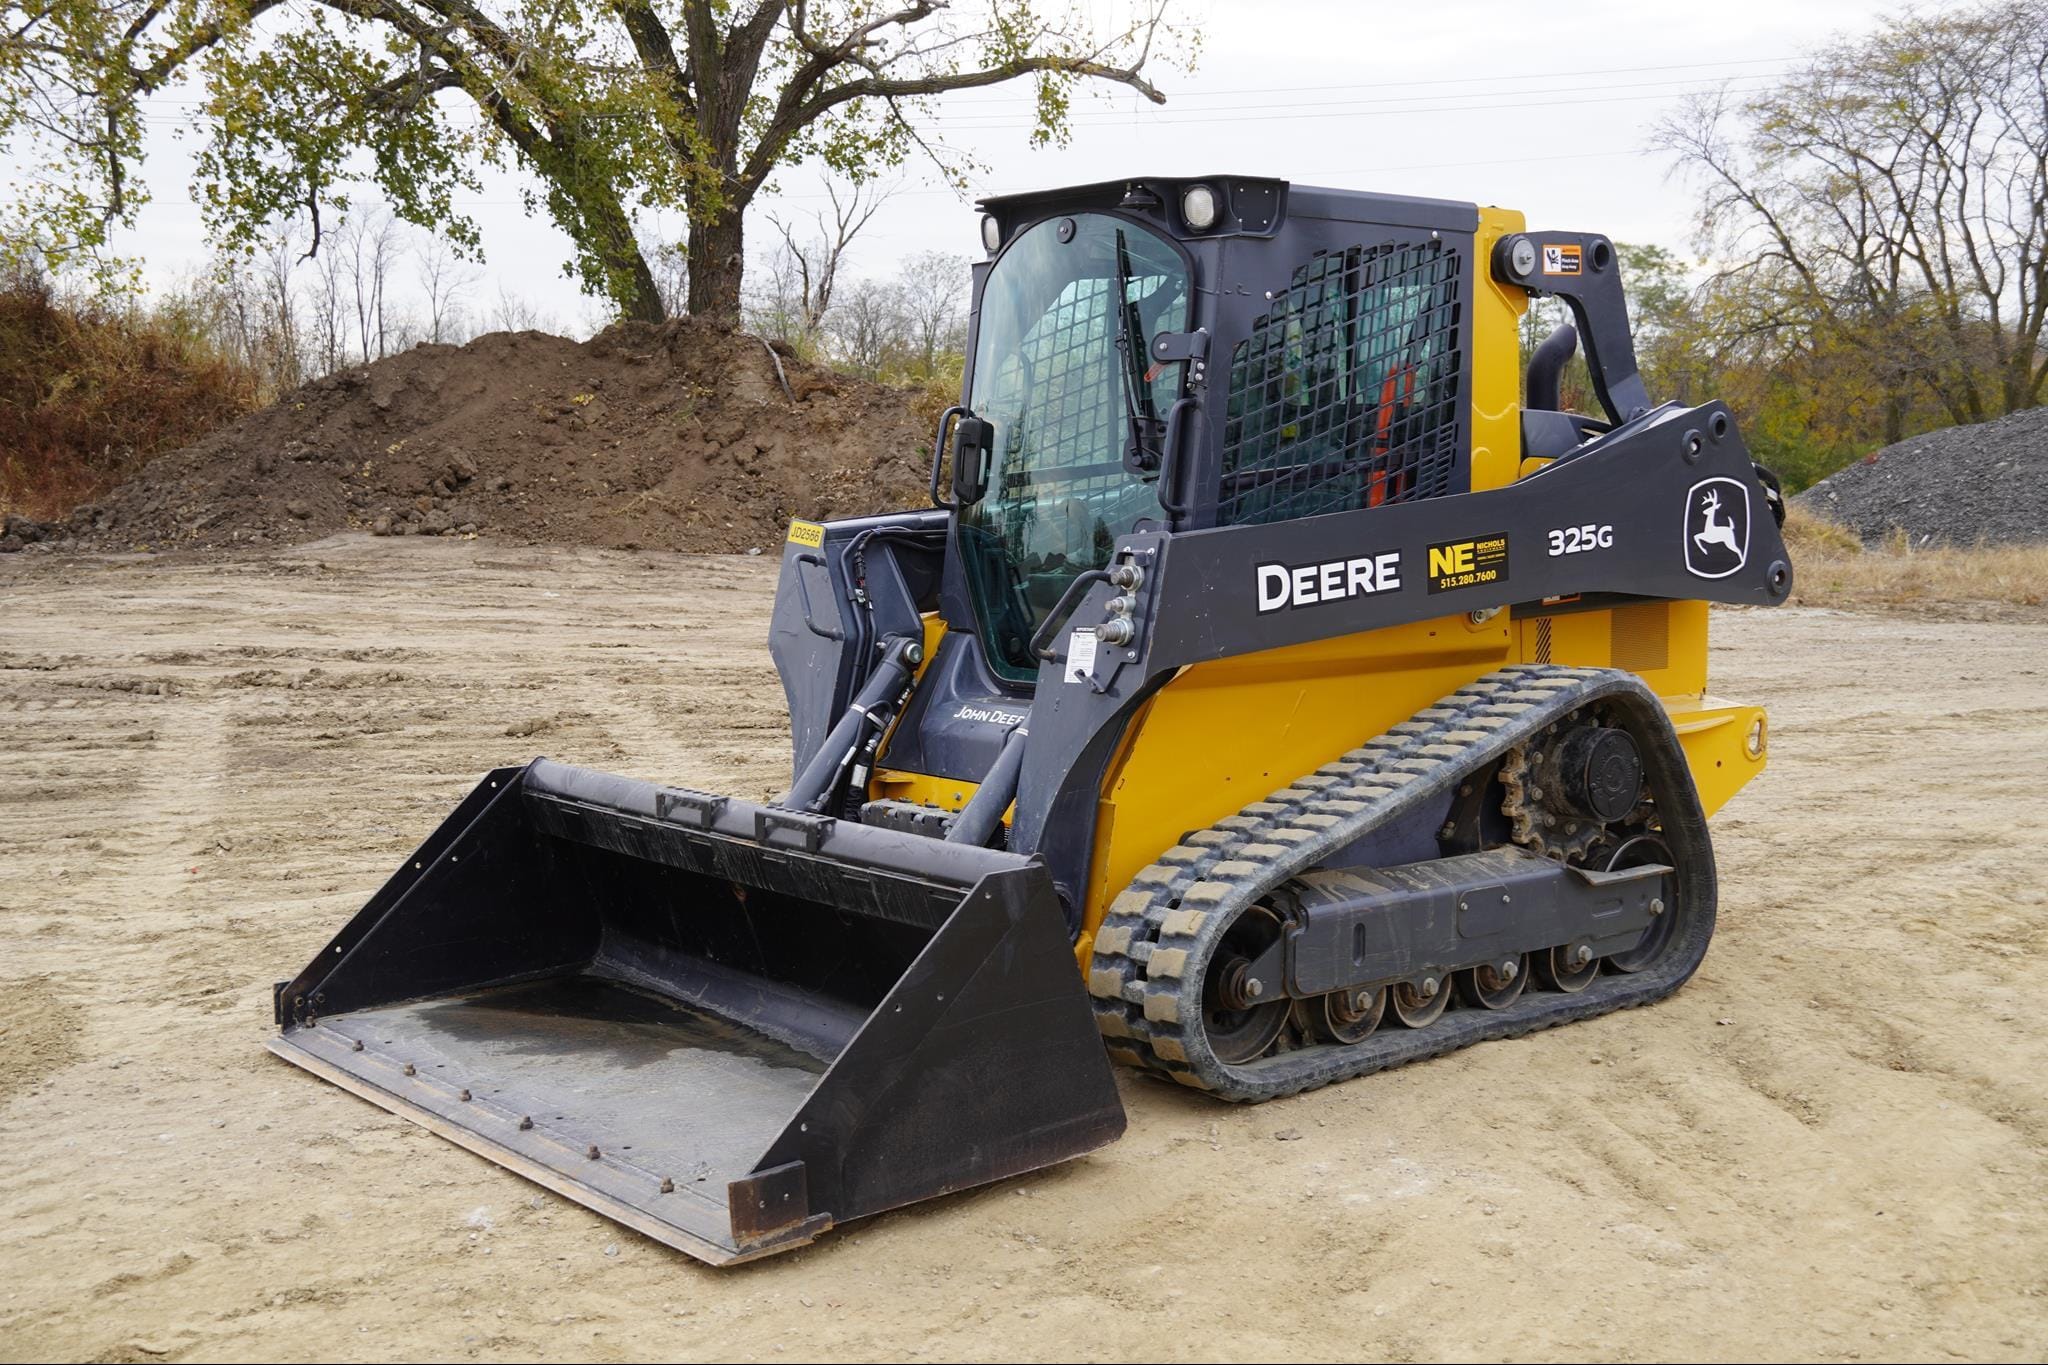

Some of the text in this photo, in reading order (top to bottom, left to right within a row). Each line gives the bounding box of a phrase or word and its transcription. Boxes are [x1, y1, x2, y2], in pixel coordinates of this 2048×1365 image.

[1477, 539, 1505, 550] NICHOLS
[1549, 524, 1613, 556] 325G
[1429, 542, 1475, 578] NE
[1257, 552, 1401, 612] DEERE
[1441, 570, 1496, 589] 515.280.7600
[953, 706, 991, 722] JOHN
